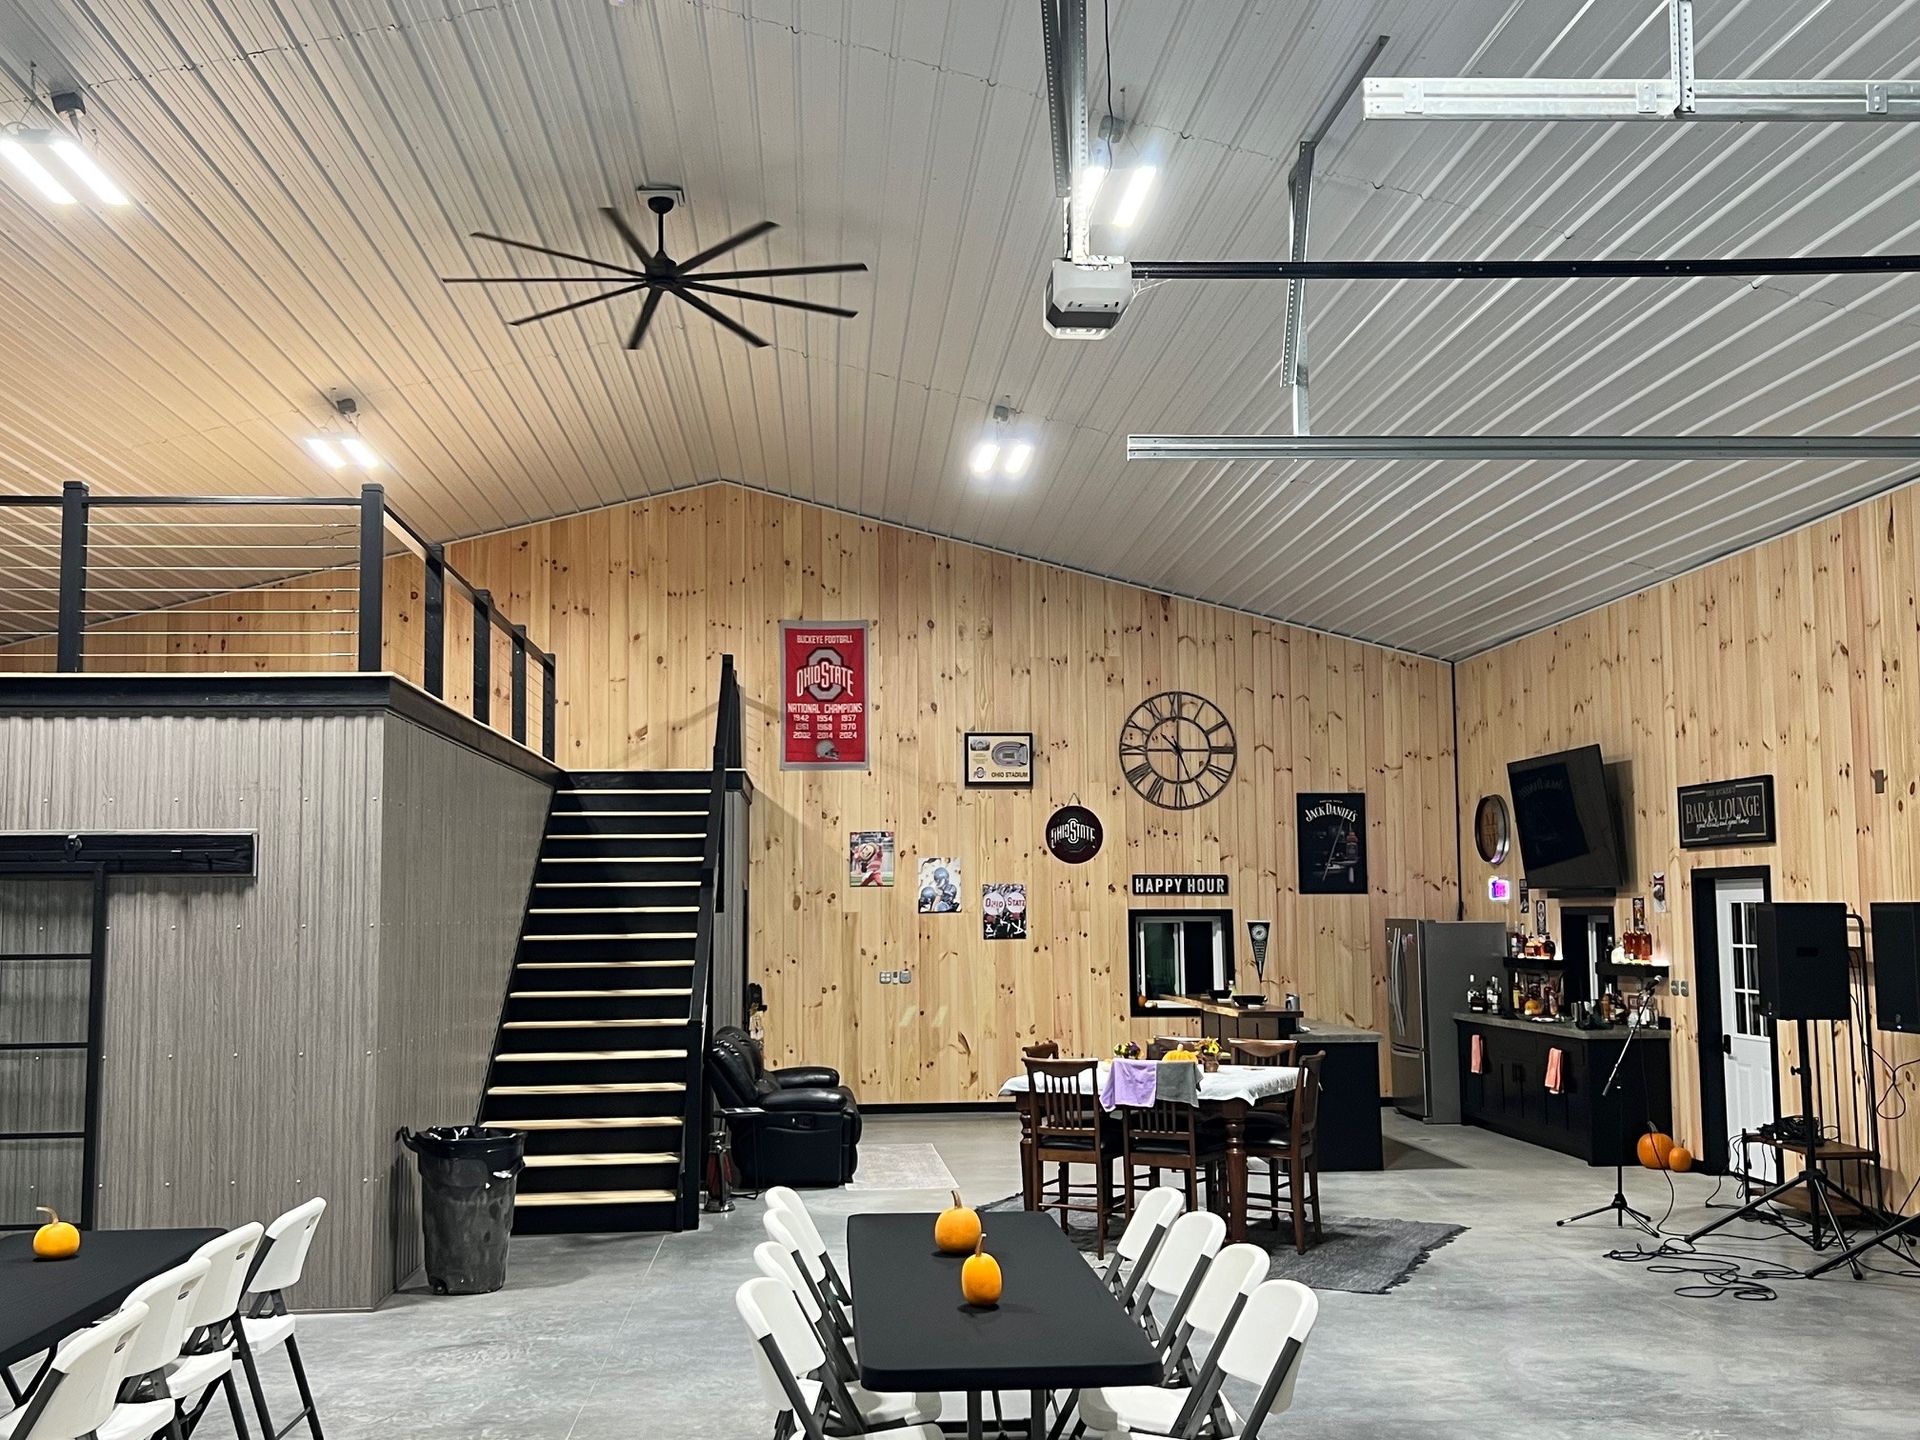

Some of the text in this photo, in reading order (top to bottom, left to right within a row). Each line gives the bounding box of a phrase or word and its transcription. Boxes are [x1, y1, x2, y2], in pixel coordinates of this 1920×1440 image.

[797, 635, 853, 643] BUCKEYE FOOTBALL
[796, 661, 854, 697] OHIO STATE
[788, 703, 862, 713] NATIONAL CHAMPIONS
[793, 714, 810, 722] 1942
[840, 722, 856, 730] 1970
[1304, 806, 1326, 822] JACK
[1686, 795, 1760, 824] BAR & LOUNGE
[1050, 823, 1070, 849] OHIO
[1135, 878, 1224, 893] HAPPY HOUR
